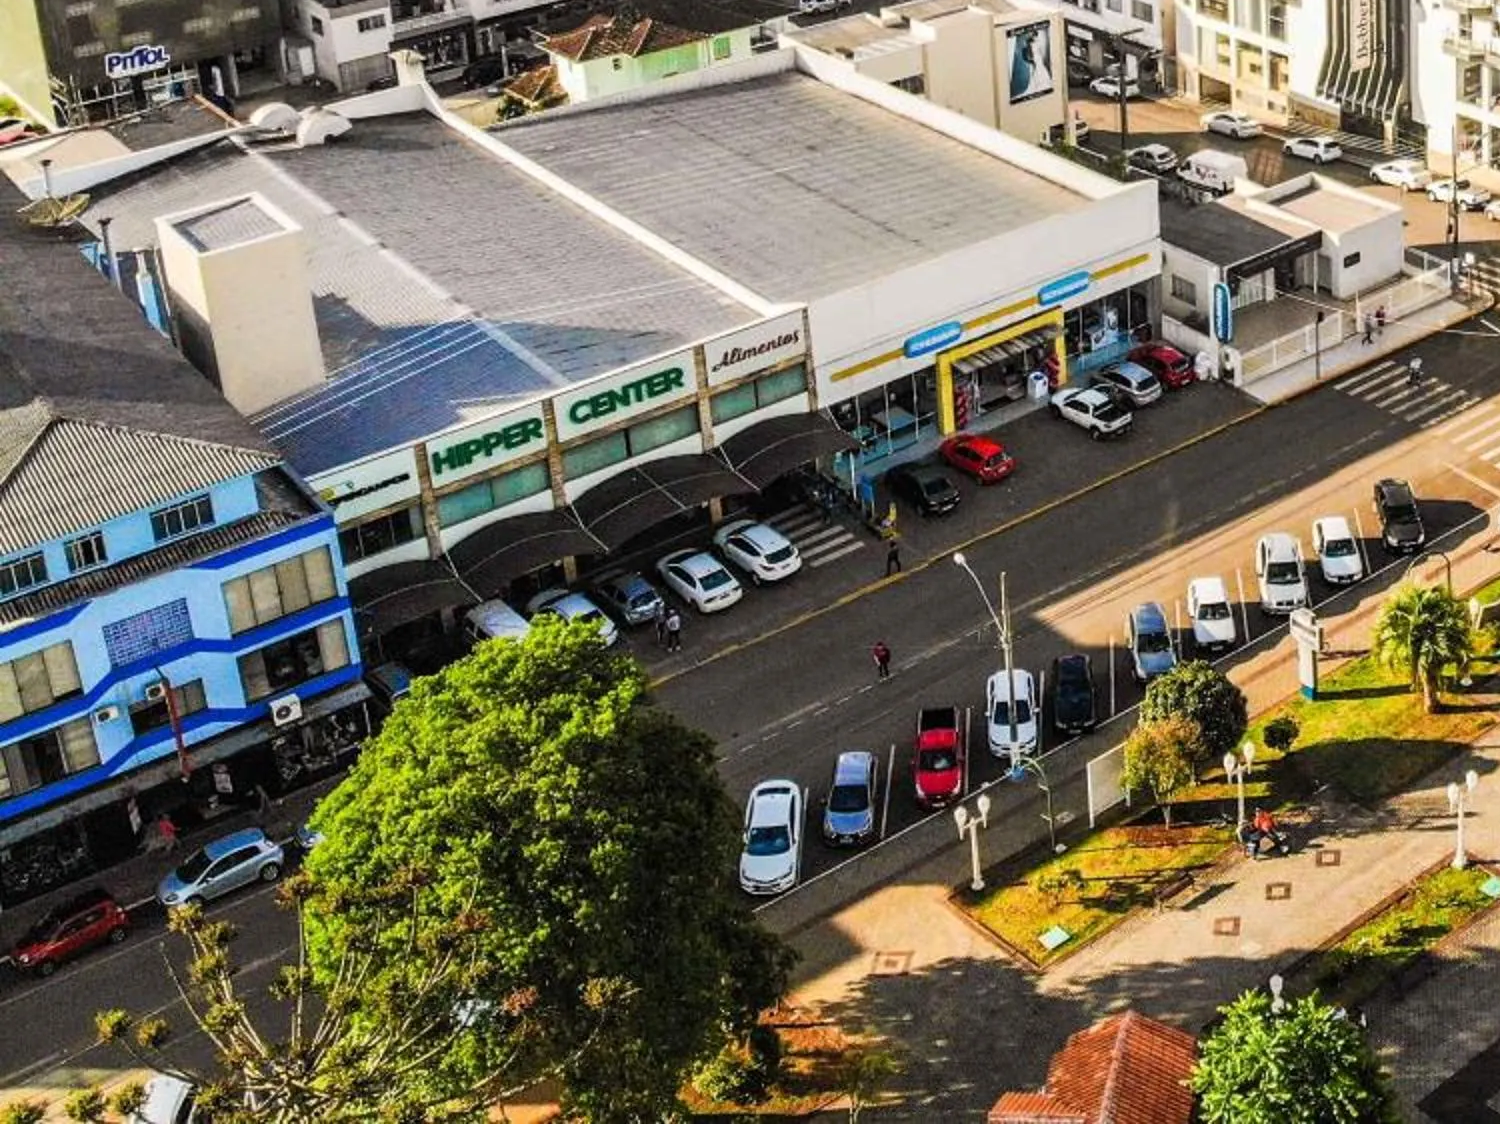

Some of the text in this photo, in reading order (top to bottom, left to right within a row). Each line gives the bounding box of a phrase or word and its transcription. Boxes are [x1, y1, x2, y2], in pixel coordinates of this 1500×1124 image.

[711, 329, 801, 373] Alimentos
[431, 367, 685, 476] HIPPER CENTER
